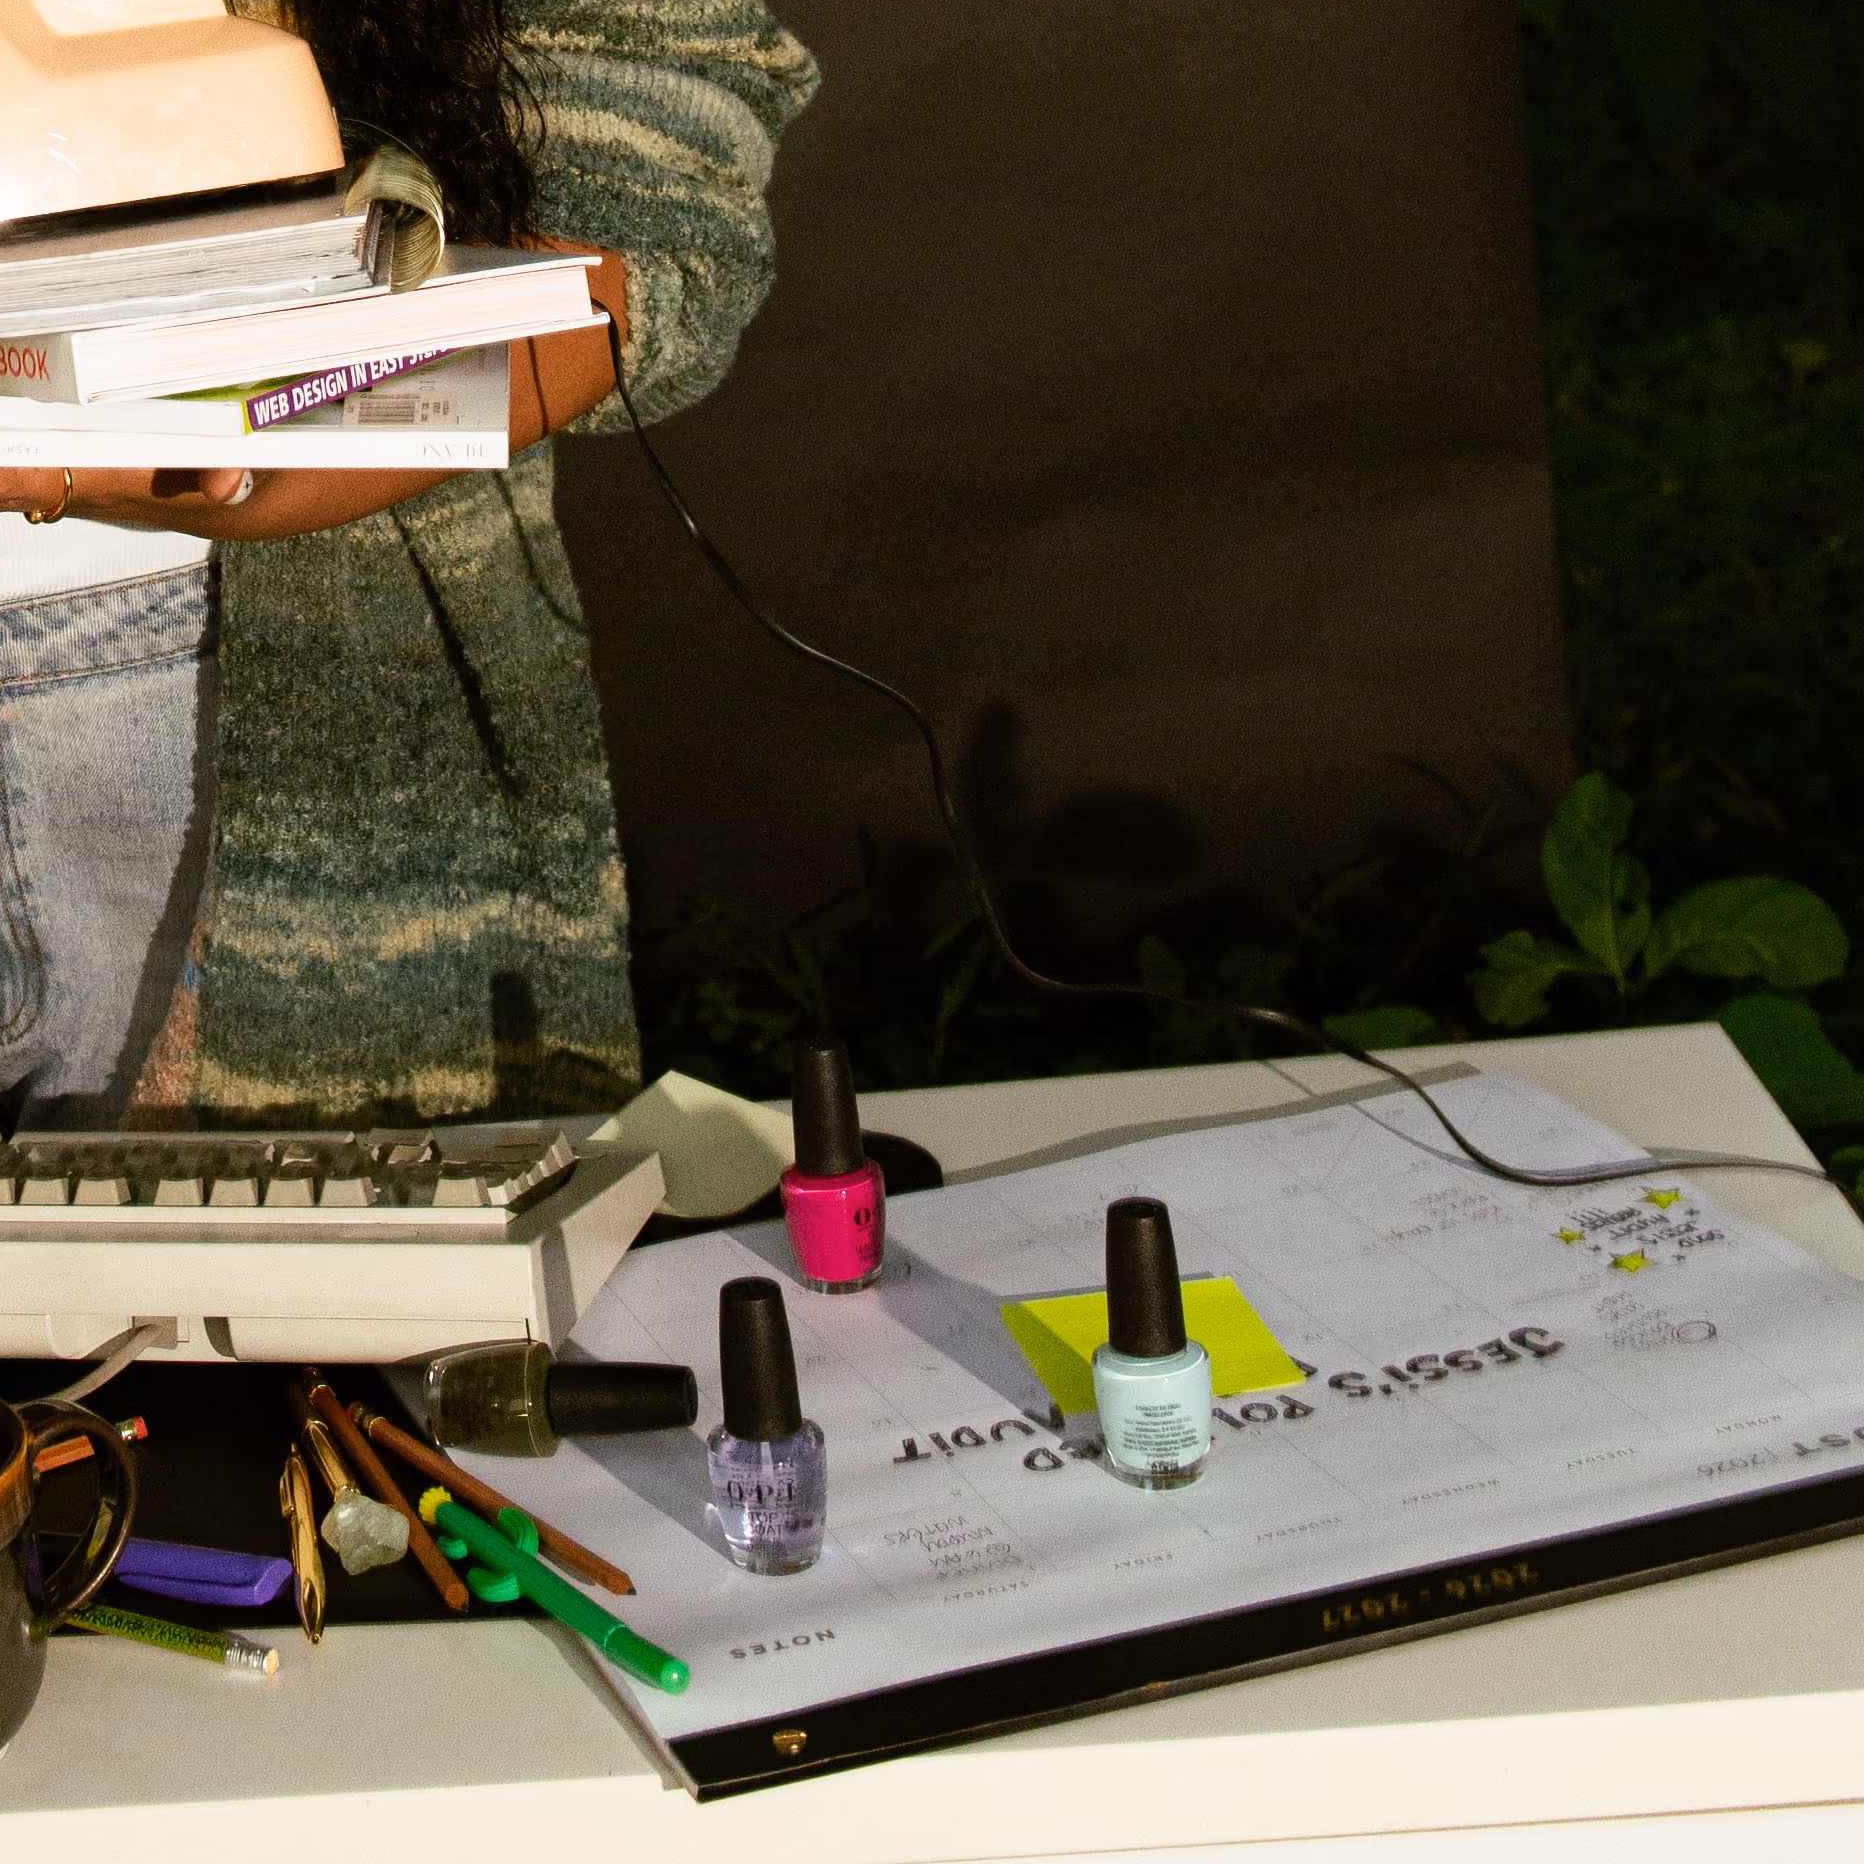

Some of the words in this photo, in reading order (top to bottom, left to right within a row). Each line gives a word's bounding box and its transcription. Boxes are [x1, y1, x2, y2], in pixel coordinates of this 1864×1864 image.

[254, 396, 289, 425] WEB
[292, 371, 348, 411] DESIGN
[350, 362, 368, 387] IN
[1328, 1326, 1565, 1398] JESSI'S
[1714, 1413, 1783, 1435] MONDAY
[1566, 1447, 1637, 1471] TUESDAY
[1401, 1477, 1502, 1506] WEDNESDAY
[1255, 1516, 1343, 1543] THURSDAY
[1114, 1552, 1174, 1572] FRIDAY
[943, 1580, 1029, 1604] SATURDAY
[729, 1628, 835, 1661] NOTES
